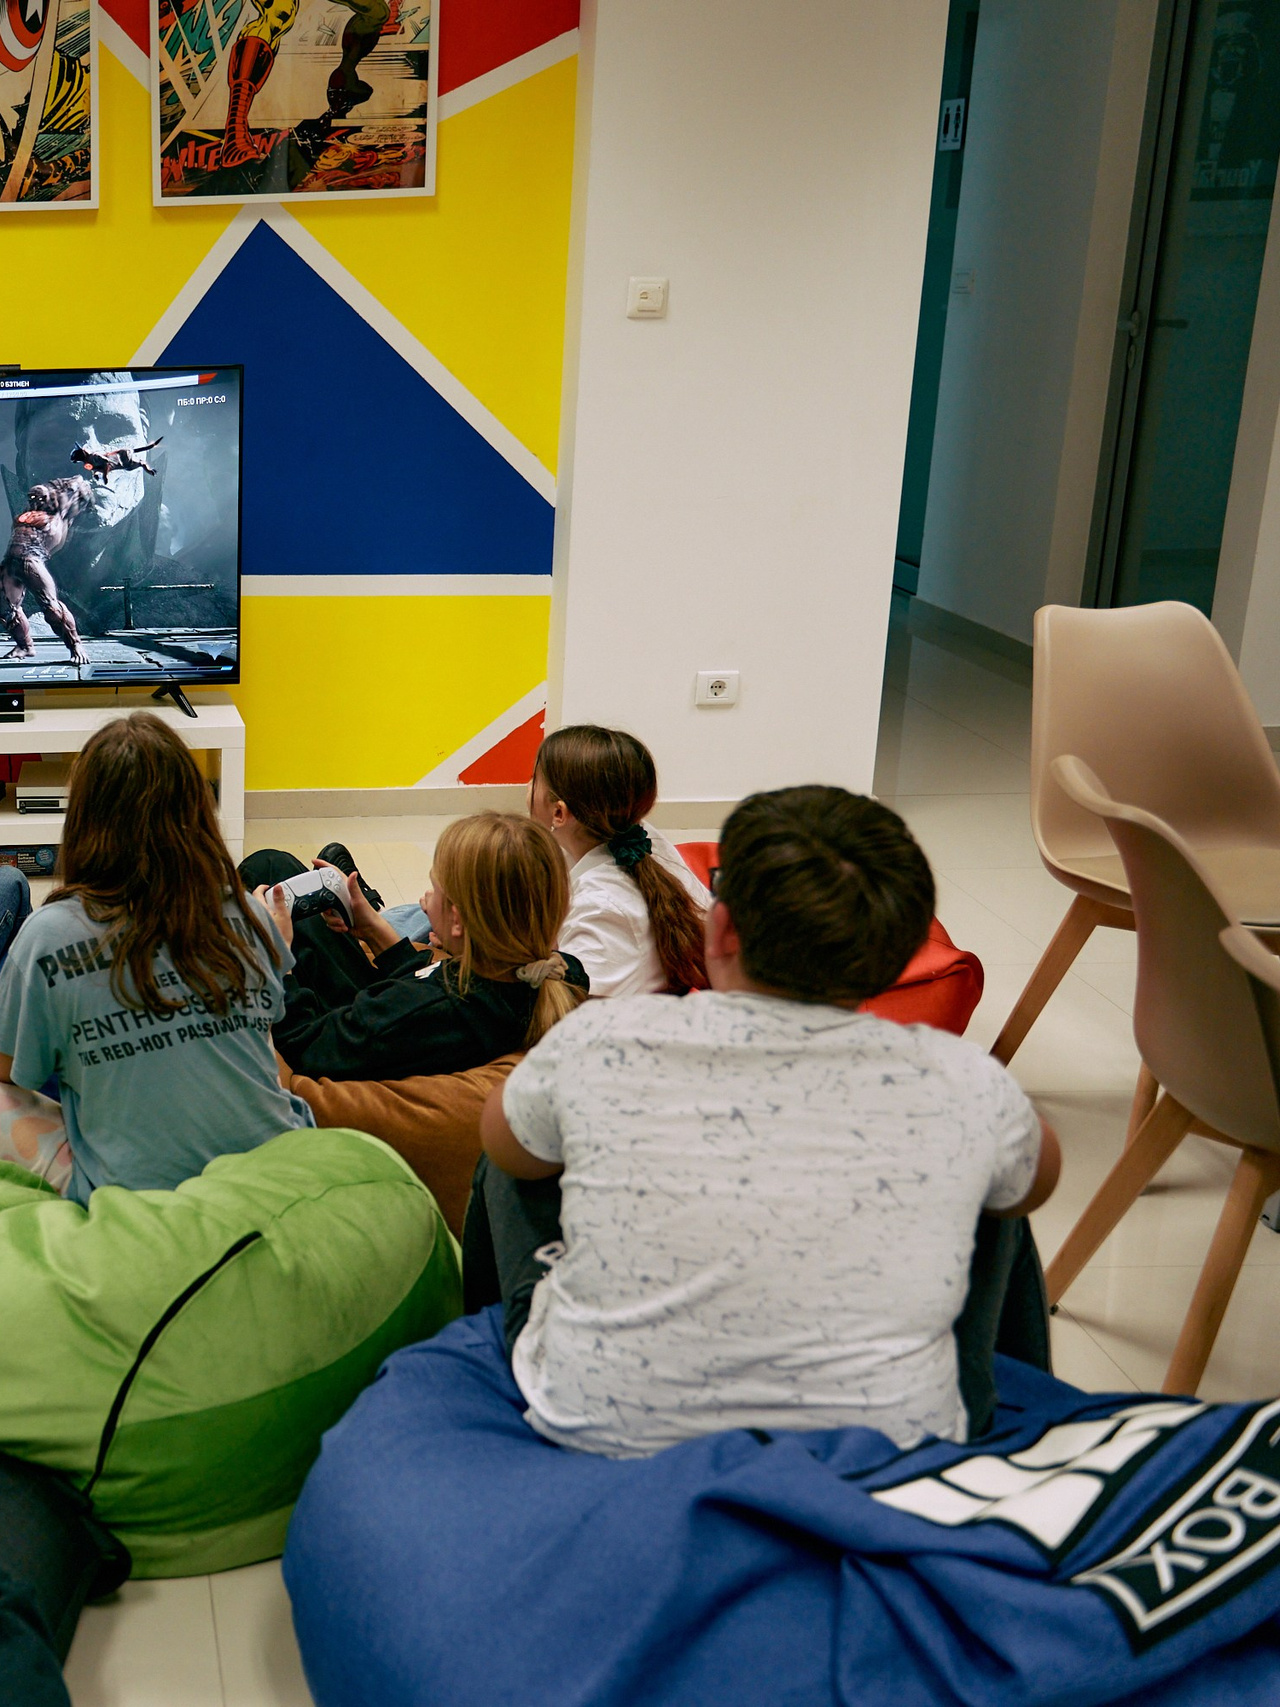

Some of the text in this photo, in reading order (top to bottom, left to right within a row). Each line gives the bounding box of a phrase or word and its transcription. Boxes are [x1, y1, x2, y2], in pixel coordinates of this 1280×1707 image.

[5, 380, 30, 388] БЭТМЕН
[78, 1050, 100, 1067] THE
[101, 1031, 173, 1063] RED-HOT
[1122, 1467, 1280, 1593] BOX
